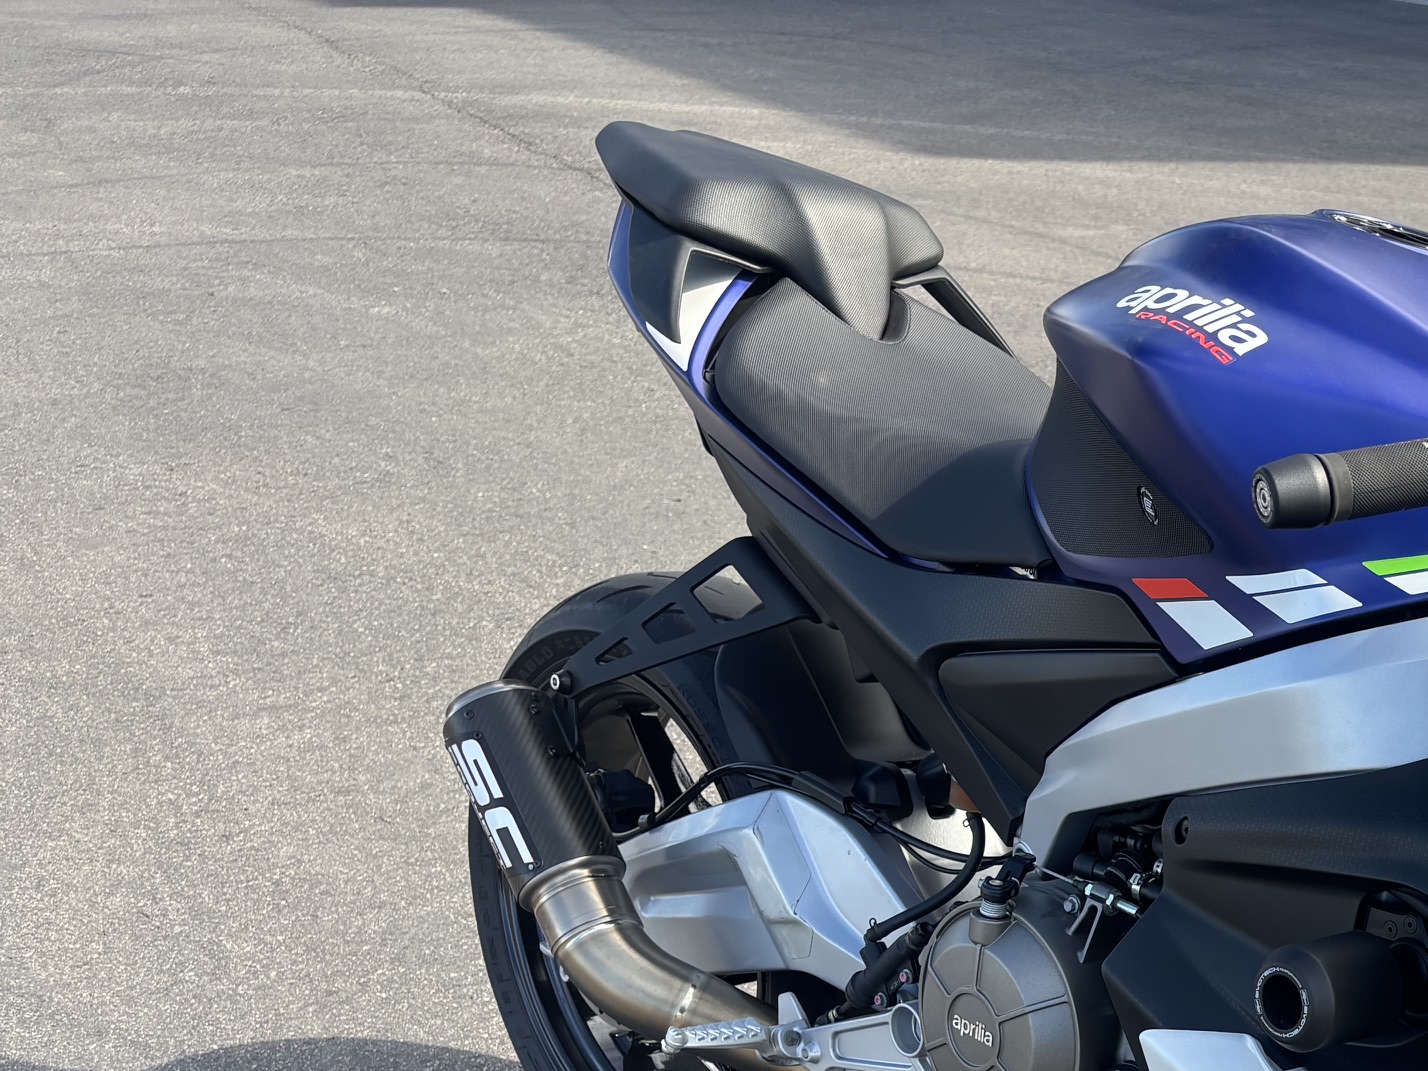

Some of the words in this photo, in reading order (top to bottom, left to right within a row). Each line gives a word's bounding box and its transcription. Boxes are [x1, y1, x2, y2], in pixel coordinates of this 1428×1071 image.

[1116, 285, 1269, 357] aprilia
[1136, 311, 1237, 366] RACING
[450, 738, 534, 870] SC
[952, 1014, 993, 1047] aprilia
